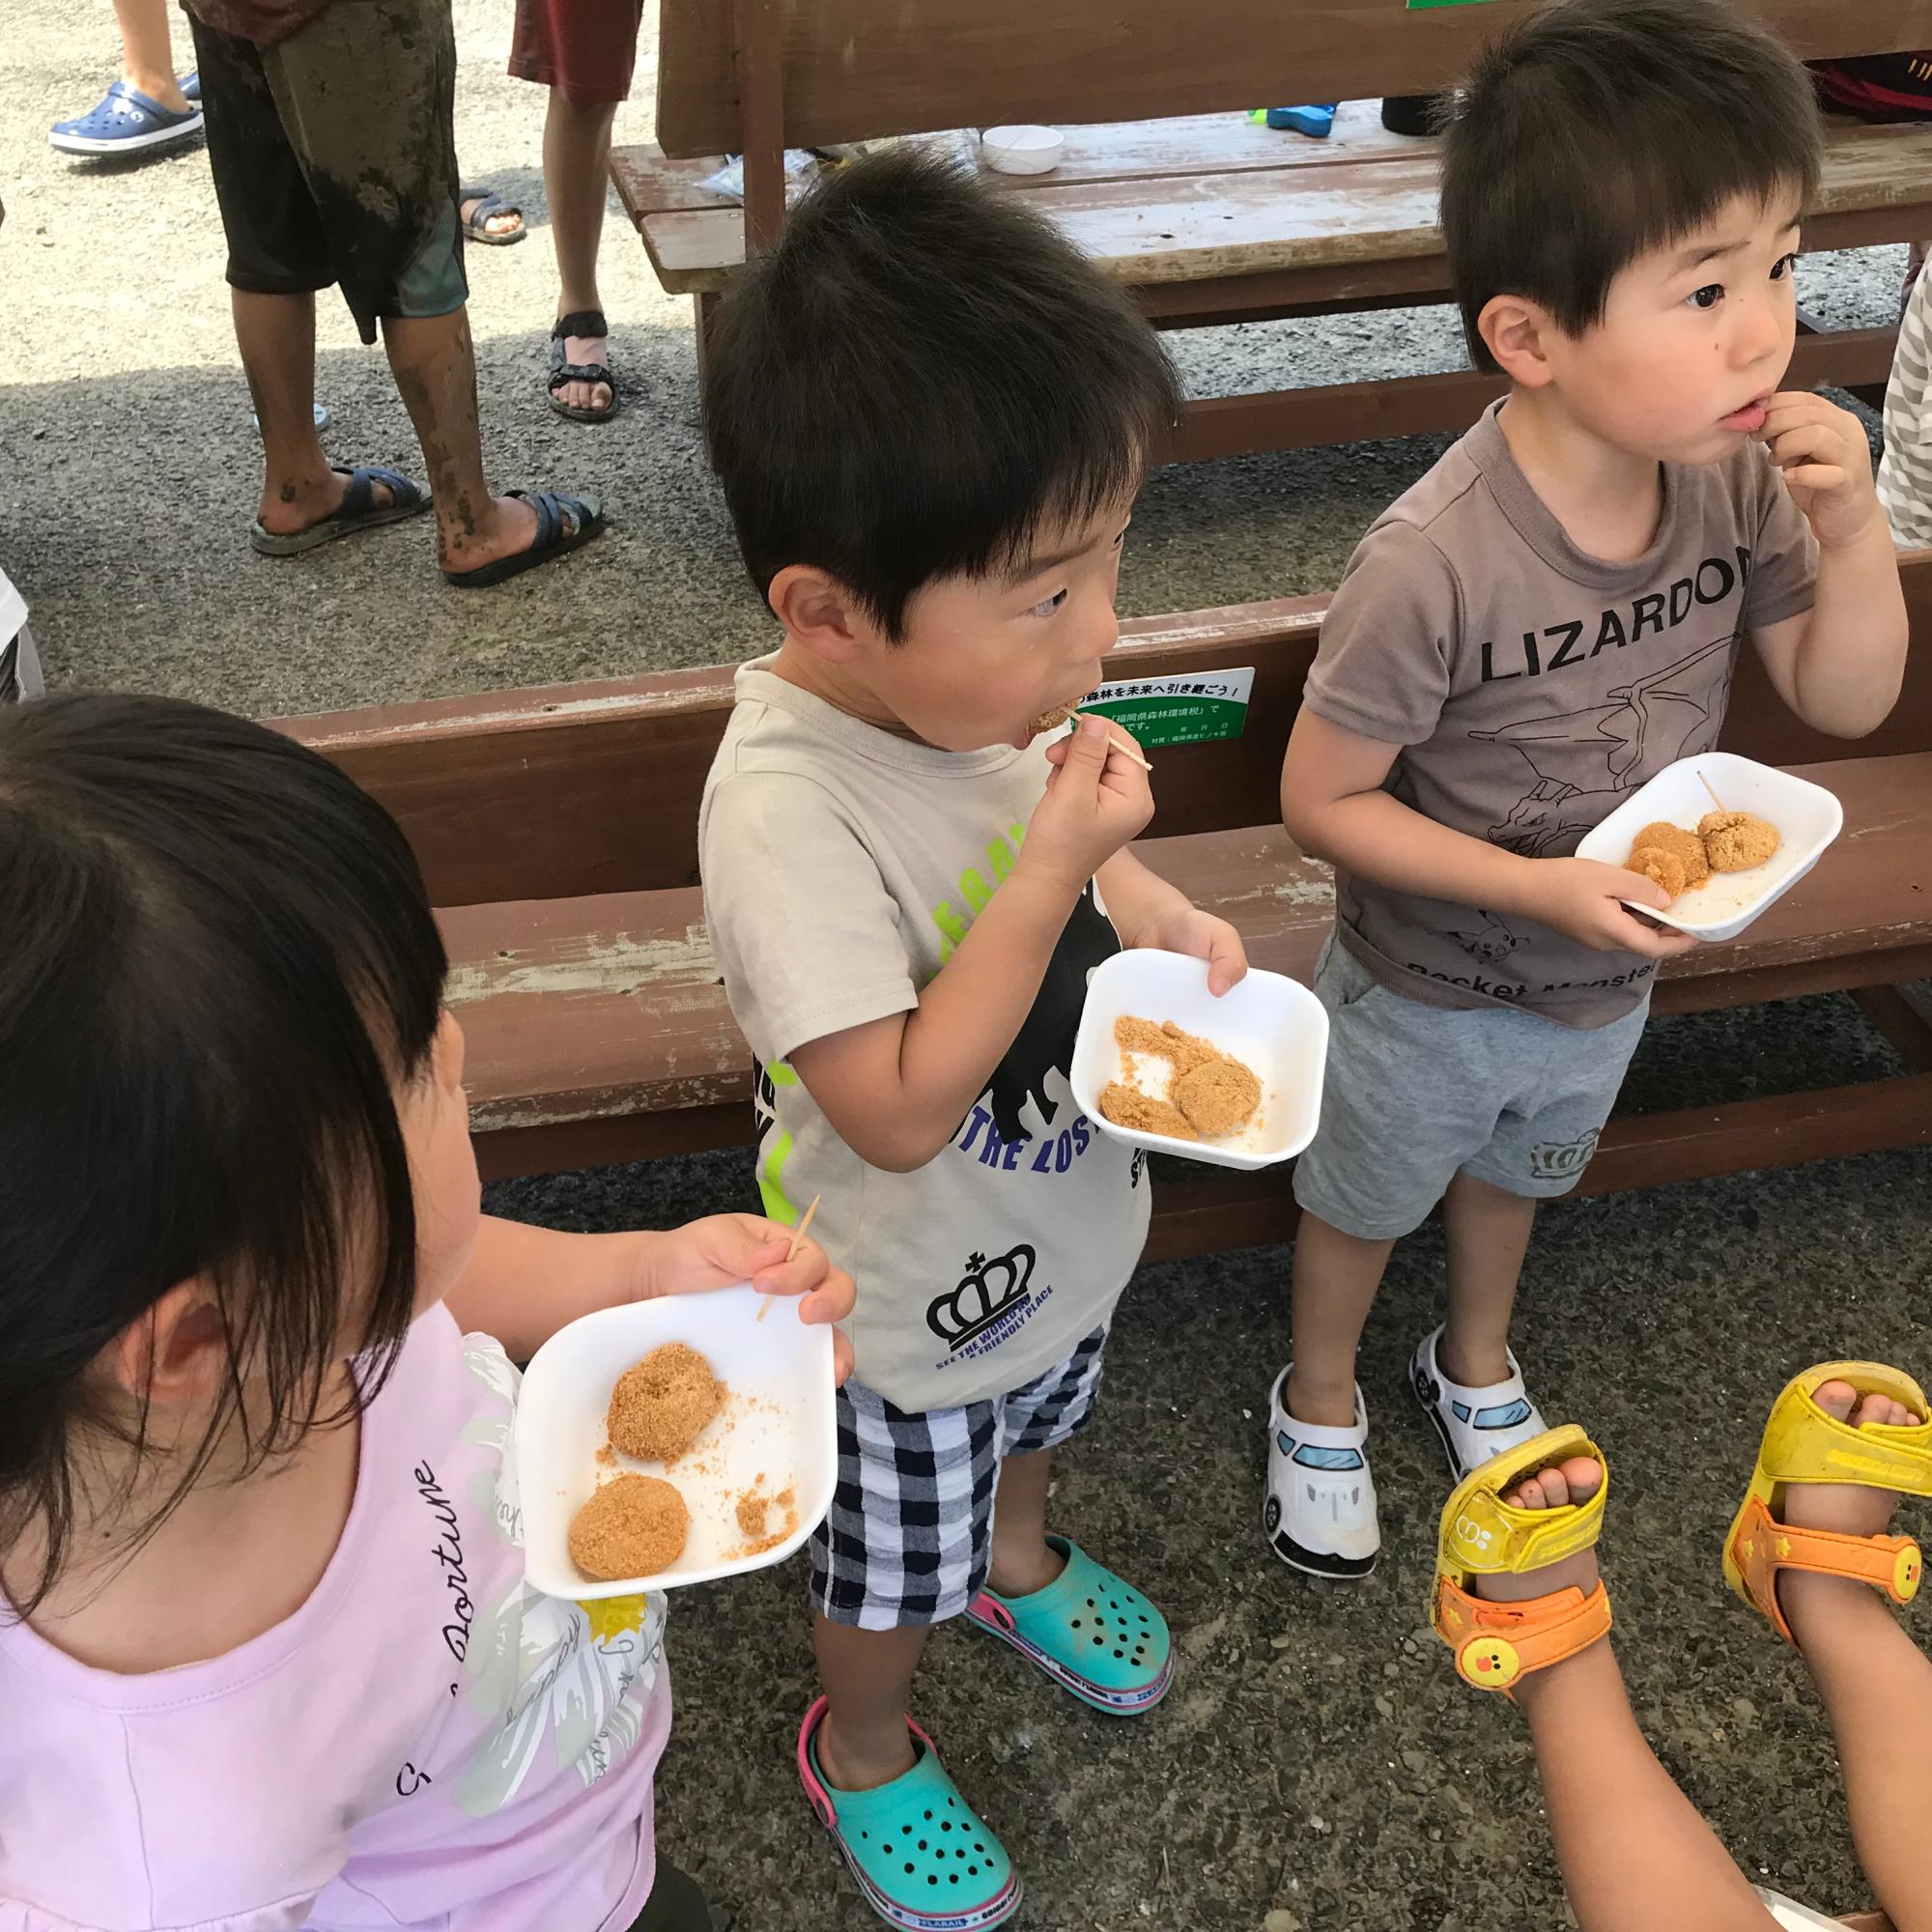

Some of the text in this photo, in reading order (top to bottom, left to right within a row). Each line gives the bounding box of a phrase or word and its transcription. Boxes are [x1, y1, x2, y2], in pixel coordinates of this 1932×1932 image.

[958, 1105, 1034, 1171] THE
[1031, 1115, 1100, 1174] LOS
[958, 1341, 980, 1359] THE
[979, 1308, 1017, 1344] WORLD
[979, 1315, 1025, 1355] FRIENDLY
[1025, 1284, 1053, 1318] PLACE
